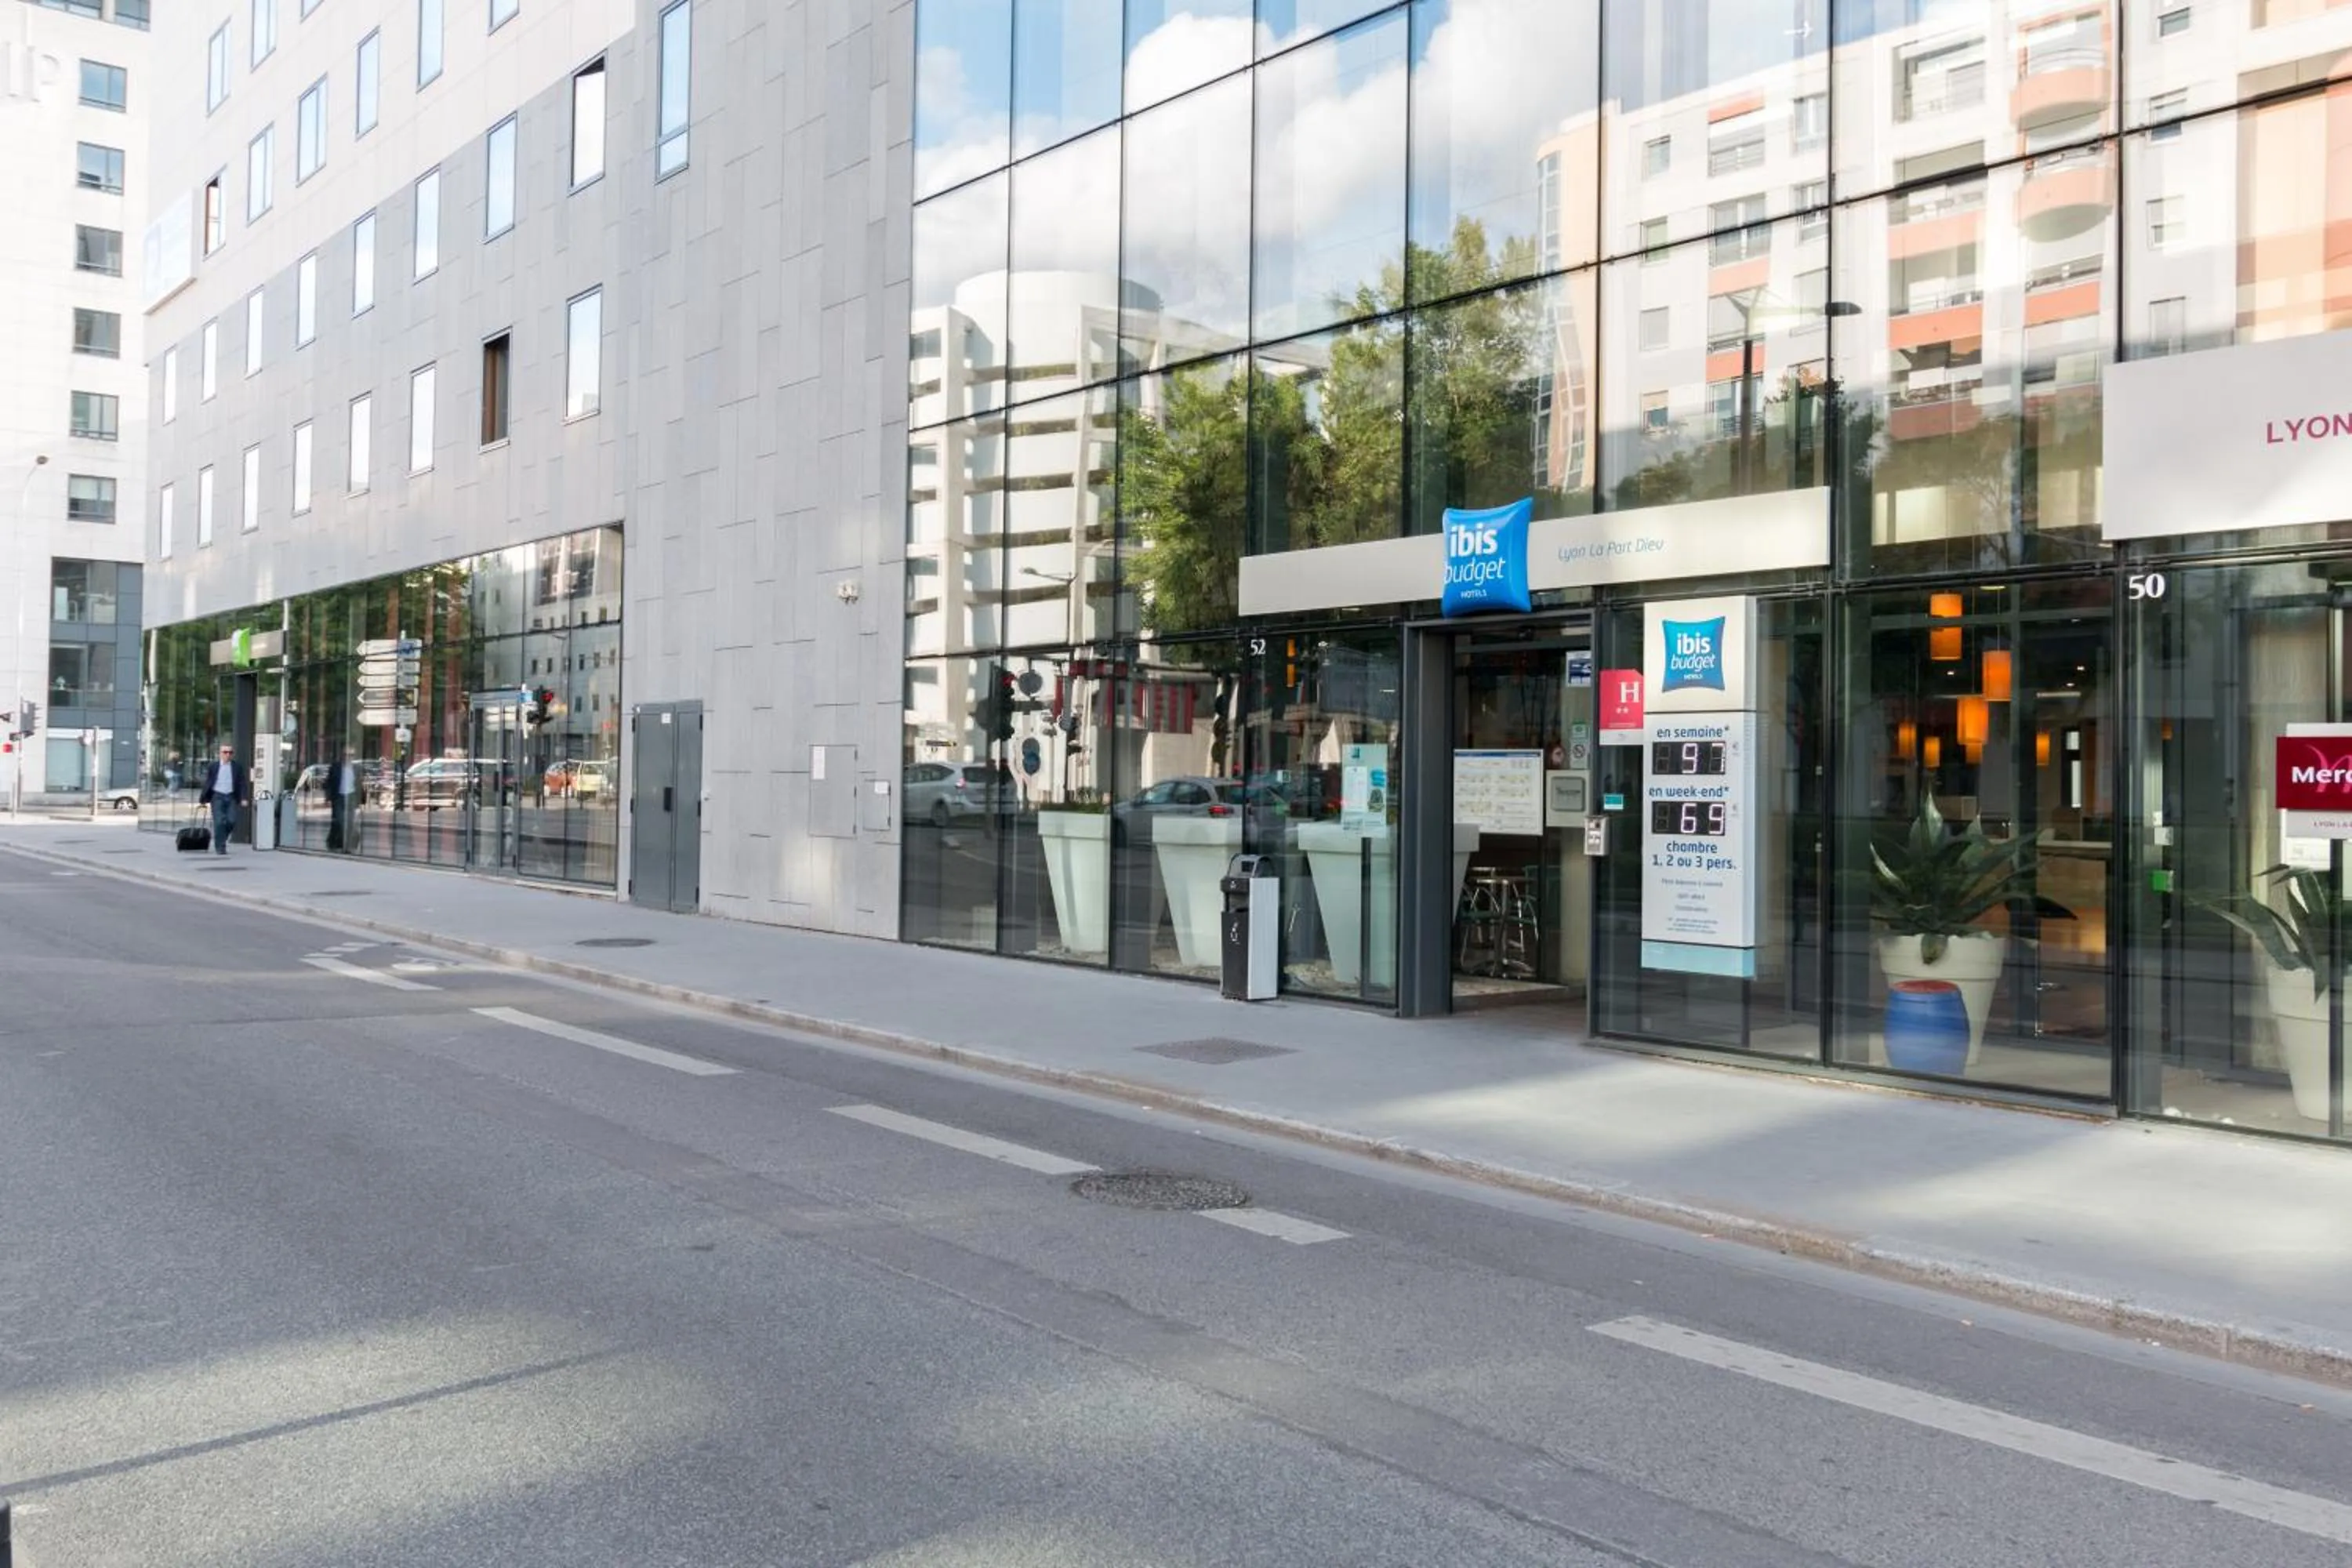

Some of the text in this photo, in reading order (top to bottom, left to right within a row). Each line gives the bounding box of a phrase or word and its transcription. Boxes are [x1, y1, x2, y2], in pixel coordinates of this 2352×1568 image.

[2267, 412, 2352, 444] LYON
[1450, 522, 1498, 557] ibis
[1558, 538, 1664, 562] Lyon La Part Dieu
[1443, 556, 1506, 586] budget
[2128, 573, 2165, 600] 50
[1250, 639, 1266, 656] 52
[1676, 632, 1711, 655] ibis
[1671, 653, 1715, 672] budget
[1620, 681, 1640, 703] H
[1657, 728, 1671, 738] en
[1682, 742, 1725, 774] 97
[1649, 787, 1663, 797] en
[1680, 802, 1724, 835] 69
[1666, 840, 1718, 854] chambre
[1666, 854, 1674, 866] 2
[1677, 857, 1692, 867] ou
[1695, 855, 1703, 868] 3
[1707, 858, 1737, 871] pers.
